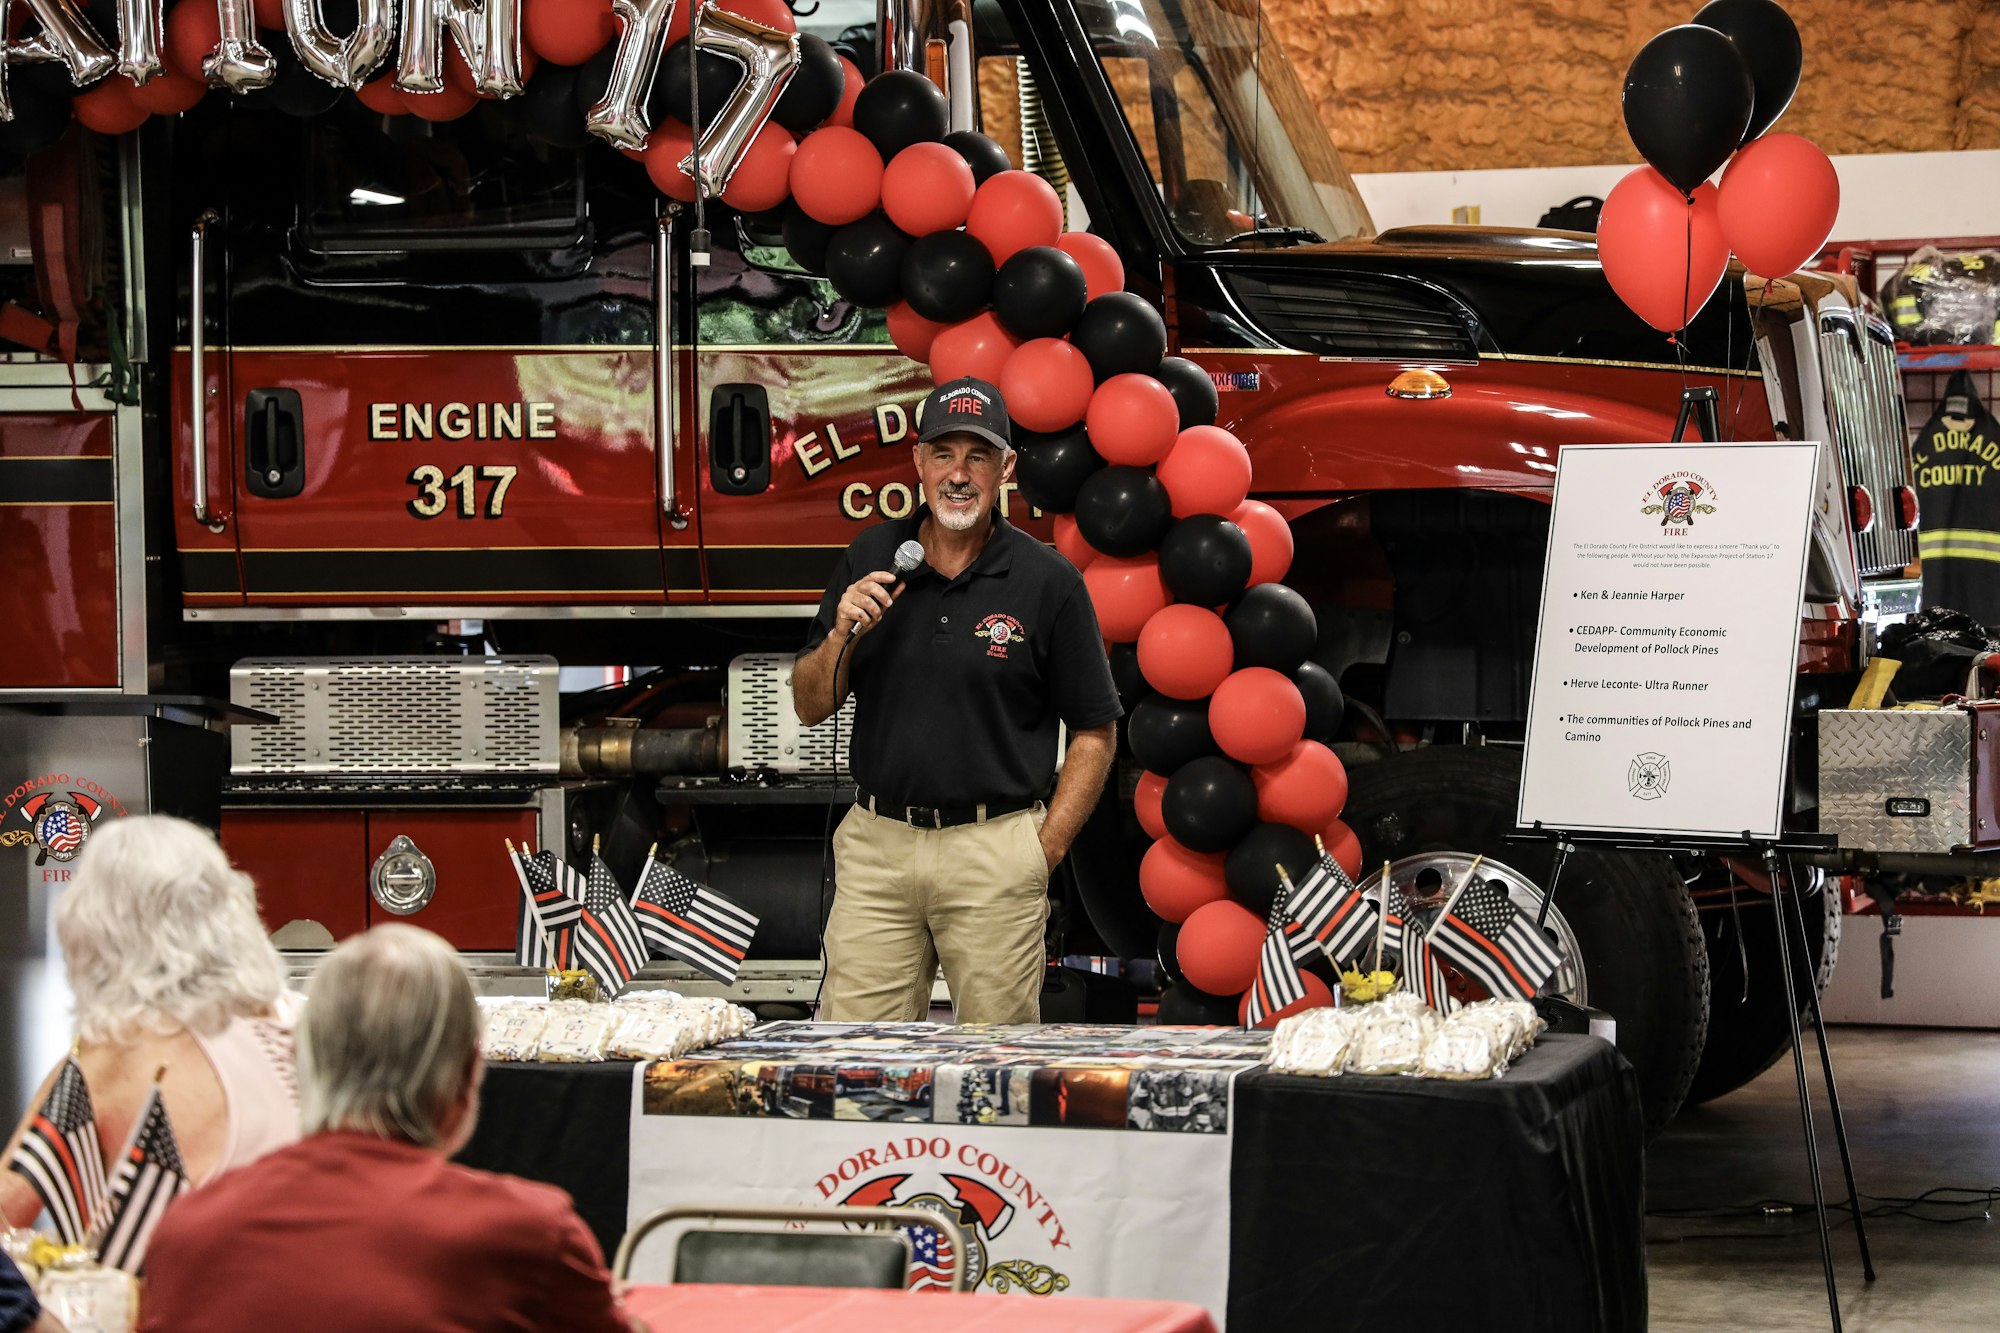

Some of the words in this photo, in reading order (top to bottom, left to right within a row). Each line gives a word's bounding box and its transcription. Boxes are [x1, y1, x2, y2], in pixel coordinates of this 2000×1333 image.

[947, 386, 971, 400] DORADO
[971, 387, 992, 406] COUNTY
[948, 397, 983, 416] FIRE
[370, 402, 557, 440] ENGINE
[793, 422, 862, 478] EL
[1919, 464, 1987, 488] COUNTY
[408, 464, 518, 518] 317
[1642, 490, 1653, 503] EL
[1653, 470, 1689, 490] DORADO
[1690, 472, 1718, 501] COUNTY
[1663, 528, 1689, 537] FIRE
[1609, 543, 1628, 551] County
[1719, 553, 1738, 561] Project
[1580, 590, 1599, 600] Ken
[1600, 590, 1609, 600] &
[1611, 590, 1648, 601] Jeannie
[1650, 590, 1685, 602] Harper
[1576, 625, 1618, 635] CEDAPP-
[1620, 626, 1677, 639] Community
[1679, 627, 1728, 638] Economic
[990, 645, 1007, 653] FIRE
[1574, 642, 1639, 655] Development
[1641, 643, 1652, 654] of
[1654, 644, 1690, 655] Pollock
[1692, 645, 1719, 655] Pines
[1570, 678, 1599, 689] Herve
[1601, 679, 1643, 690] Leconte-
[1645, 680, 1669, 690] Ultra
[1672, 680, 1709, 691] Runner
[1567, 714, 1584, 724] The
[1586, 715, 1649, 726] communities
[1651, 716, 1663, 726] of
[1664, 716, 1700, 727] Pollock
[1702, 718, 1730, 728] Pines
[1732, 719, 1752, 729] and
[1565, 731, 1601, 742] Camino
[4, 773, 71, 807] DORADO
[76, 777, 129, 817] COUNT
[54, 804, 71, 813] Est.
[43, 868, 72, 883] FIR
[814, 1137, 951, 1200] DORADO
[957, 1144, 1072, 1251] COUNTY
[966, 1242, 980, 1283] EMS
